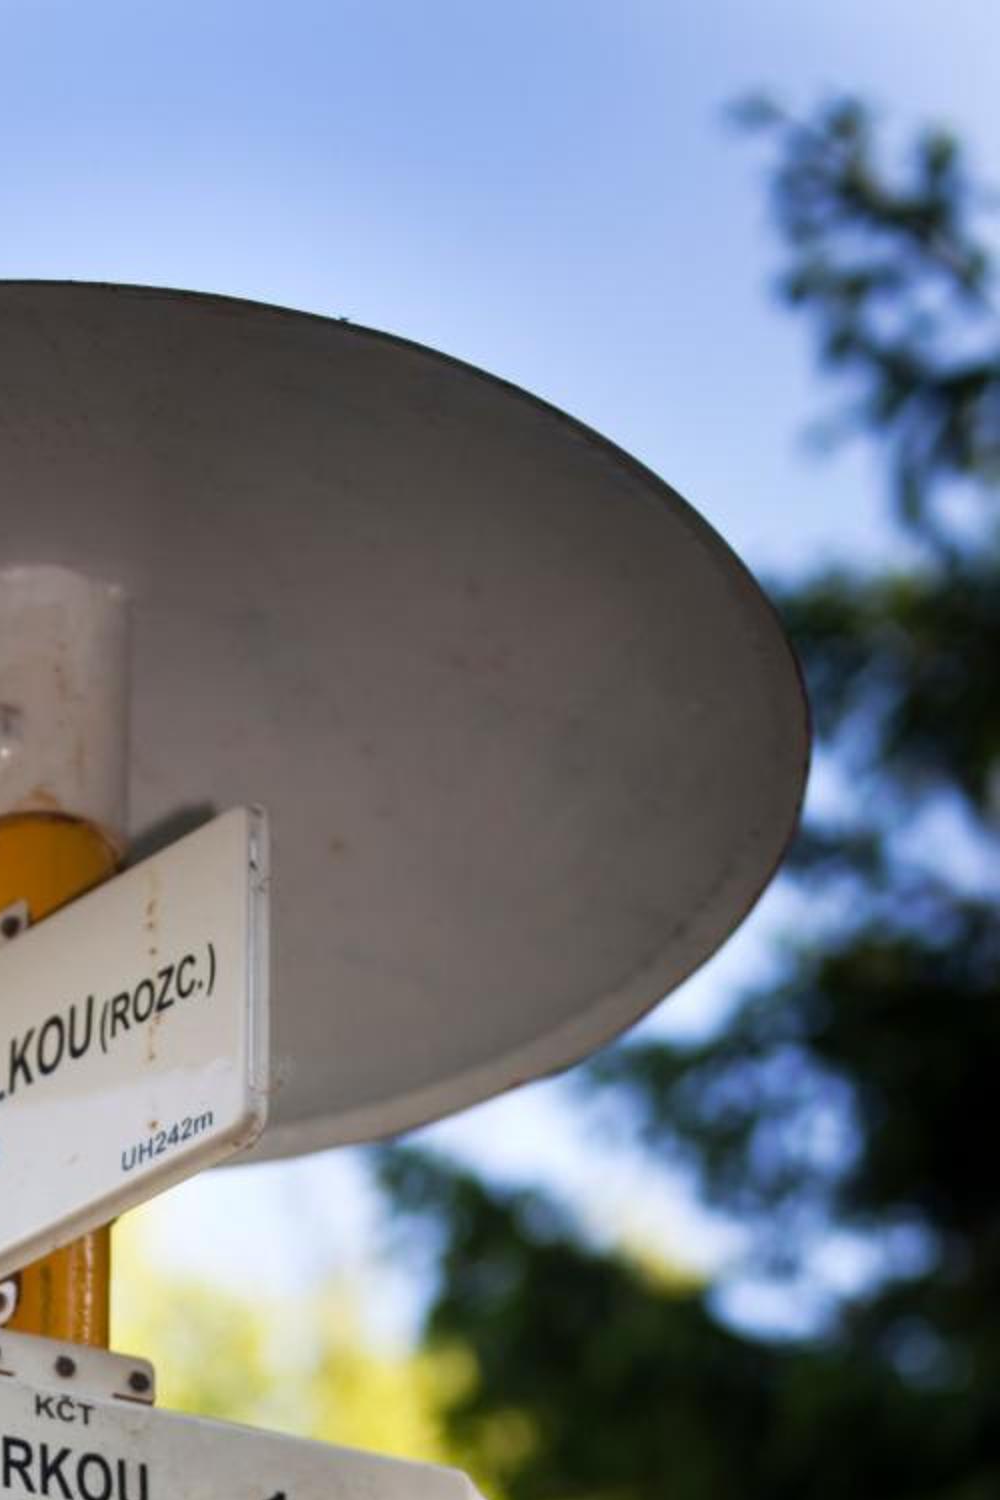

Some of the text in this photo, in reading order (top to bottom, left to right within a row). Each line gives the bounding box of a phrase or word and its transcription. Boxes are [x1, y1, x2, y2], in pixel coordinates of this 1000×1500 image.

[98, 943, 217, 1053] (ROZC.)
[121, 1109, 214, 1172] UH242m
[34, 1392, 96, 1426] KČT
